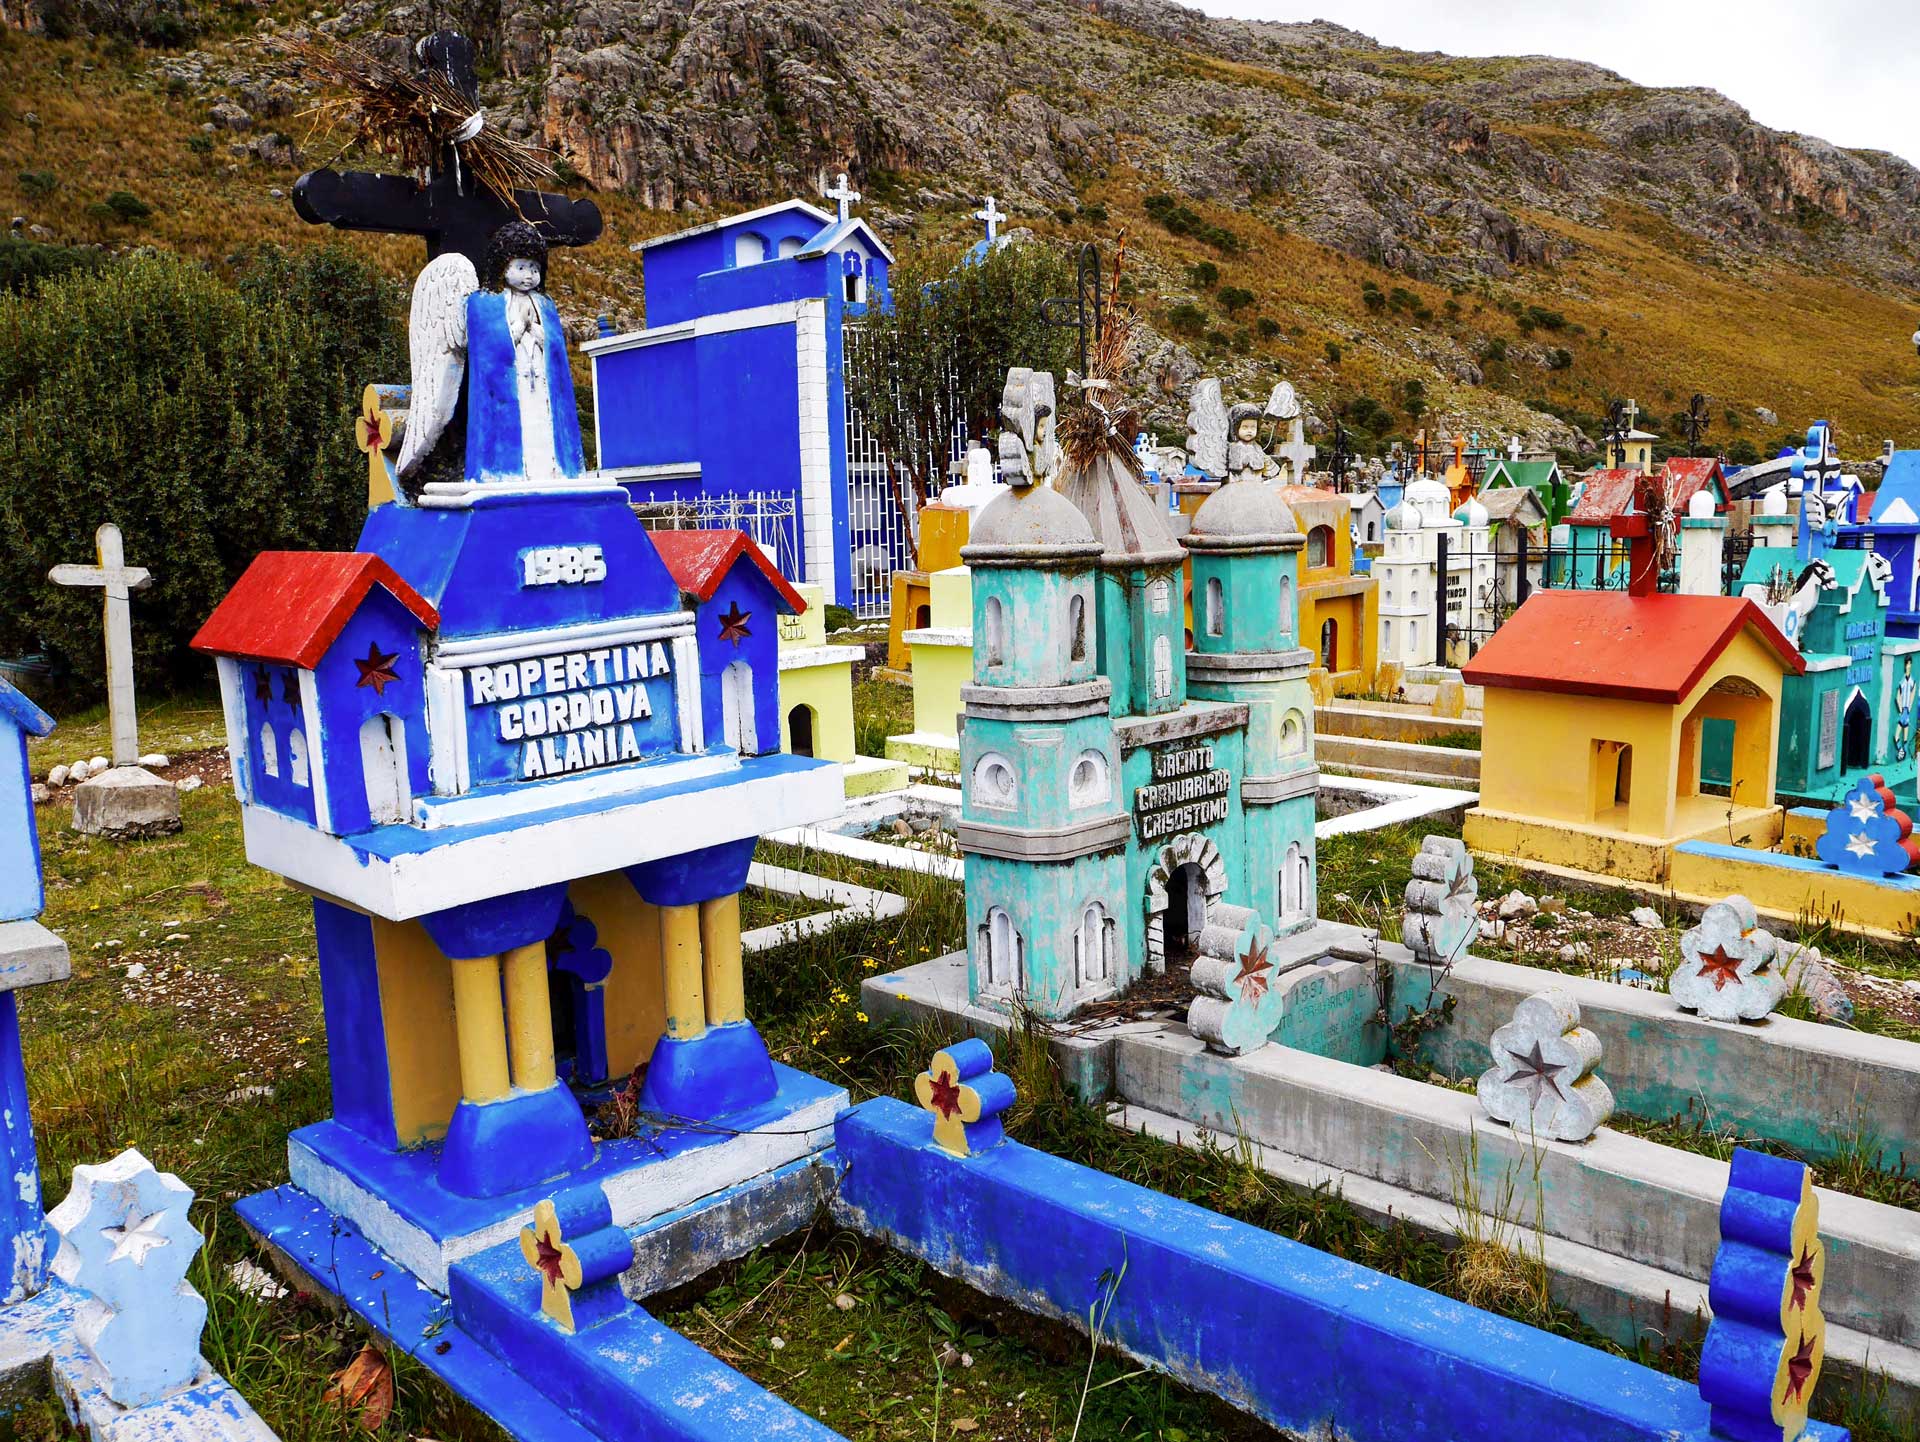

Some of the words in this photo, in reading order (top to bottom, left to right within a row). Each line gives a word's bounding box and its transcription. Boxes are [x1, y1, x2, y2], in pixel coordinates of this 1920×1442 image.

[523, 546, 607, 586] 1985
[1446, 575, 1460, 586] UAN
[470, 641, 671, 705] ROPERTINA
[500, 682, 653, 741] CORDOVA
[523, 723, 641, 778] ALANIA
[1155, 746, 1215, 778] JACINTO
[1137, 768, 1232, 812] CARHUARICRA
[1142, 796, 1230, 839] CRISOSTOMO
